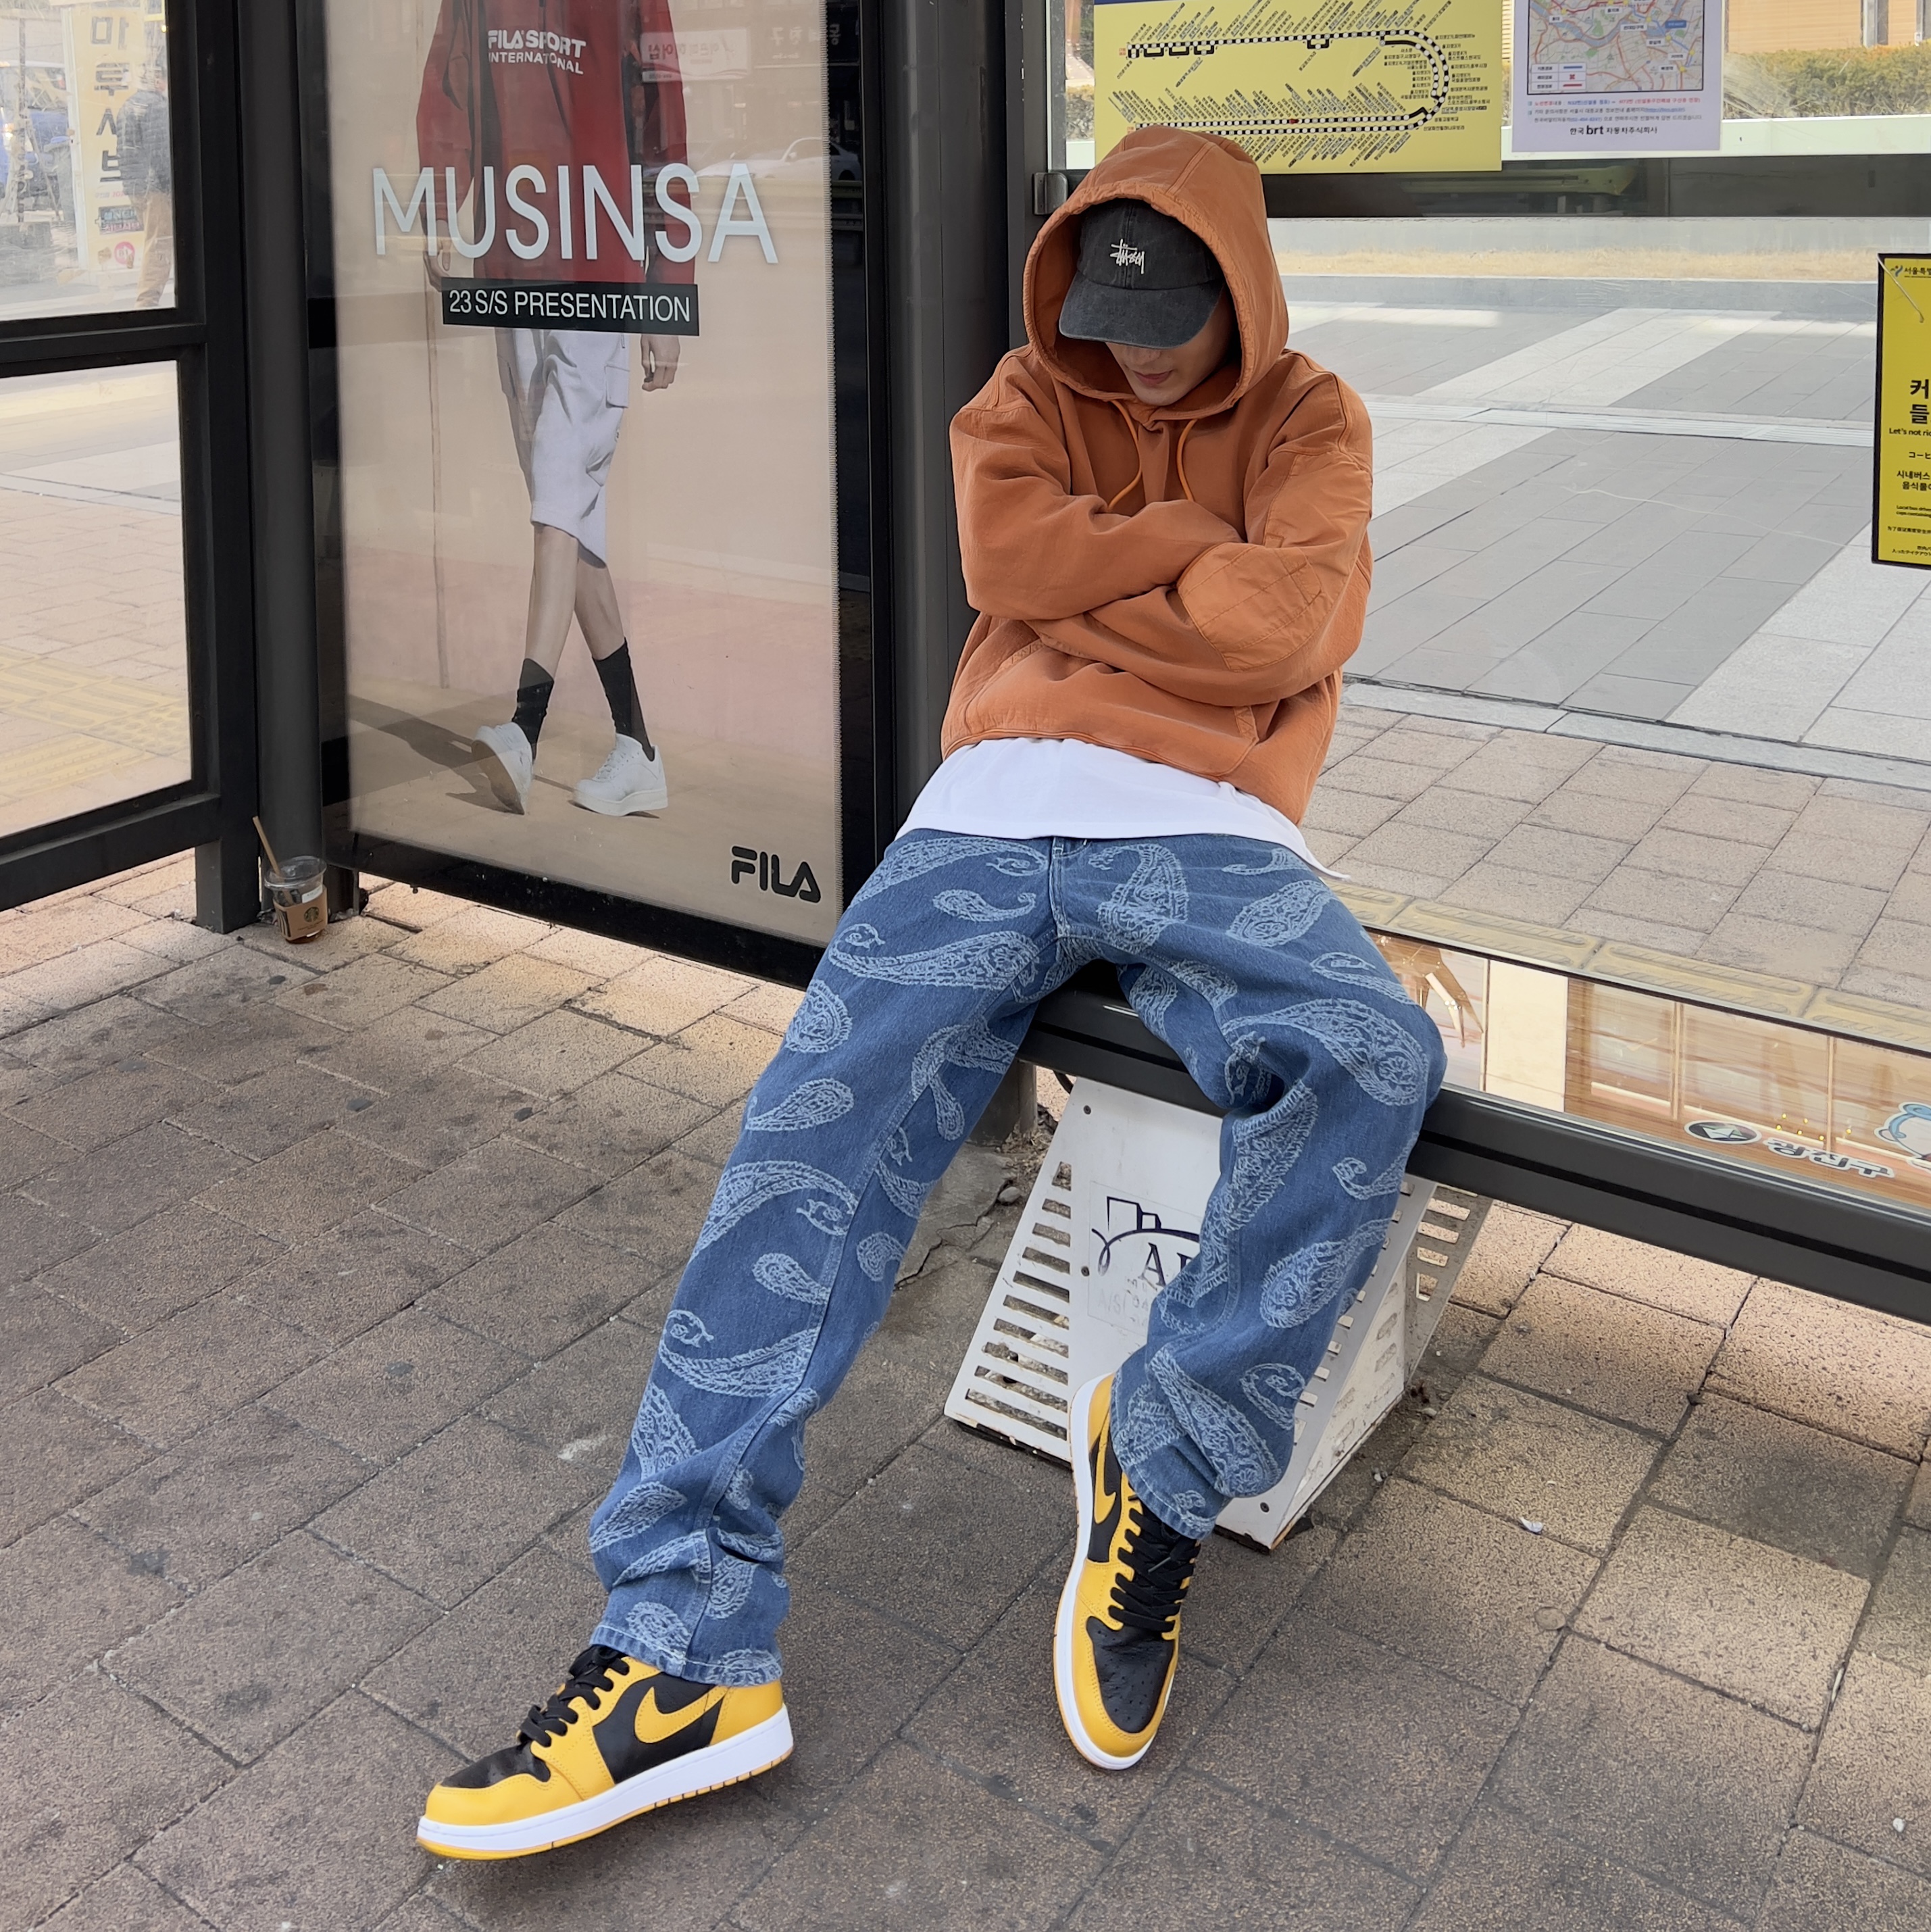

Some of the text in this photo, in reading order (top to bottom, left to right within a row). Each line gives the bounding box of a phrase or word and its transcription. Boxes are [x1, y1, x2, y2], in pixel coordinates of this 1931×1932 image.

[488, 29, 524, 49] FILA
[1570, 126, 1584, 135] 한국
[1586, 125, 1604, 135] brt
[372, 164, 778, 264] MUSINSA
[449, 290, 690, 323] 23 S/S PRESENTATION
[1889, 427, 1907, 435] Let's
[1897, 470, 1930, 480] 시내버스
[731, 845, 822, 903] FILA
[1767, 1138, 1890, 1176] 광진구
